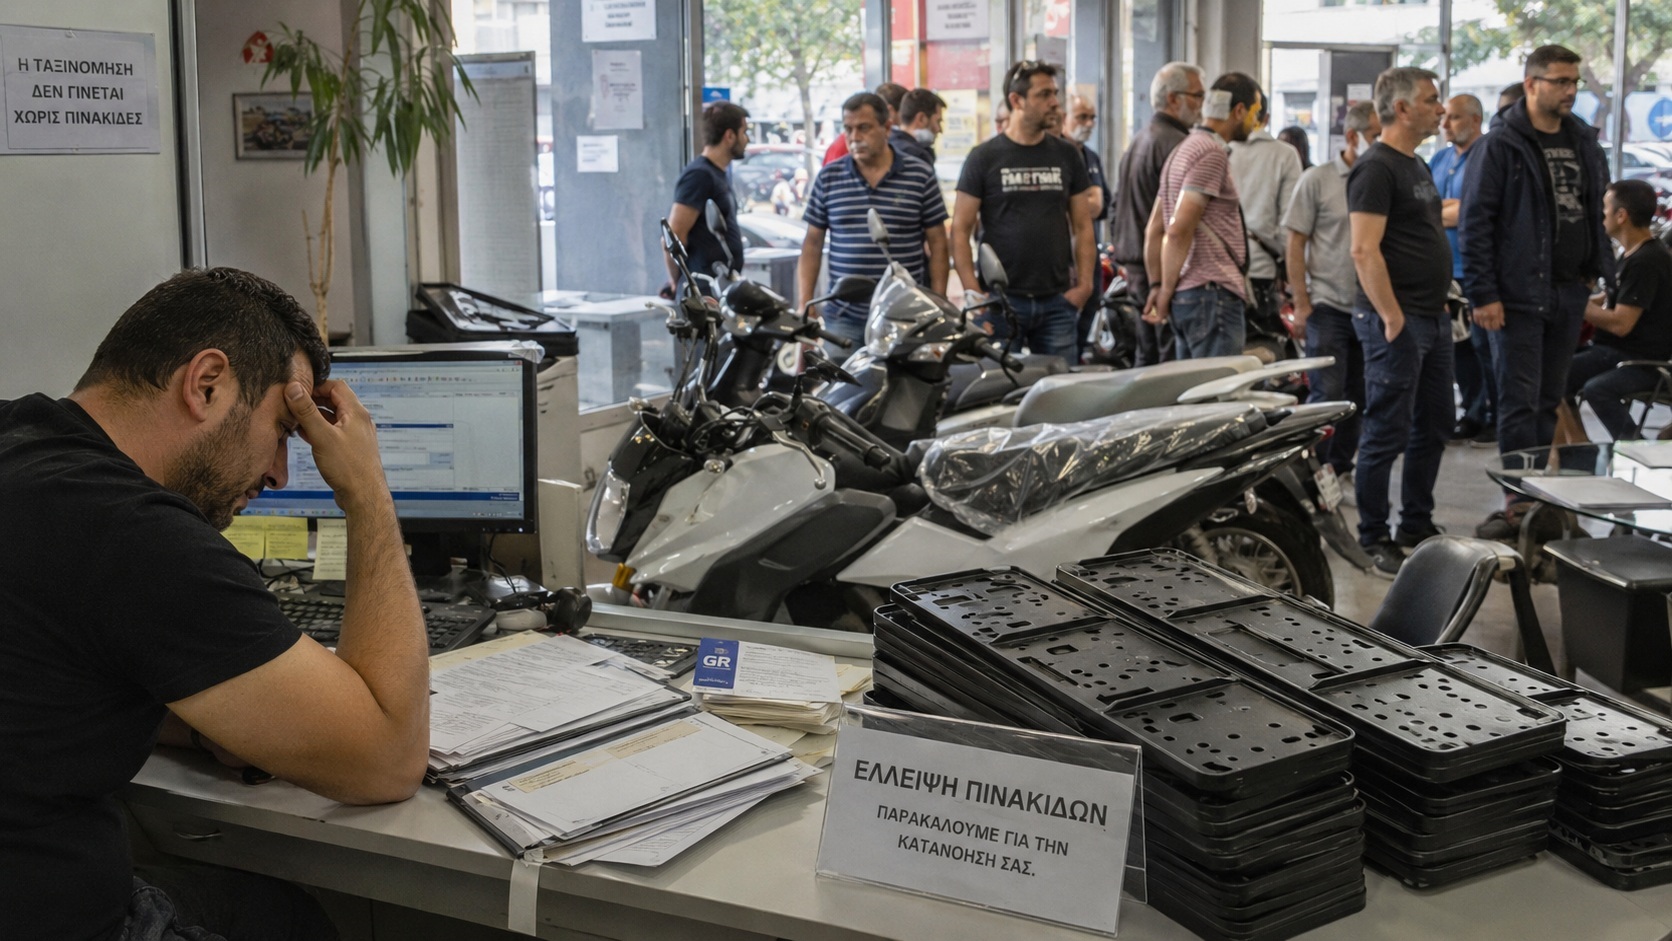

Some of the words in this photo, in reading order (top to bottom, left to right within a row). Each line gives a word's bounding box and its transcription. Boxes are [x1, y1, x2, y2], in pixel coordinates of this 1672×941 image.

[18, 58, 29, 71] Η
[33, 59, 133, 76] ΤΑΞΙΝΟΜΗΣΗ
[32, 85, 63, 98] ΔΕΝ
[68, 86, 124, 100] ΓΙΝΕΤΑΙ
[14, 110, 60, 124] ΧΩΡΙΣ
[65, 111, 143, 125] ΠΙΝΑΚΙΔΕΣ
[703, 655, 731, 668] GR
[854, 759, 958, 798] ΕΛΛΕΙΨΗ
[965, 780, 1108, 826] ΠΙΝΑΚΙΔΩΝ
[877, 805, 999, 843] ΠΑΡΑΚΑΛΟΥΜΕ
[1004, 831, 1029, 850] ΓΙΑ
[1035, 836, 1069, 856] ΤΗΝ
[898, 834, 996, 868] ΚΑΤΑΝΟΗΣΗ
[1000, 857, 1036, 877] ΣΑΣ.
